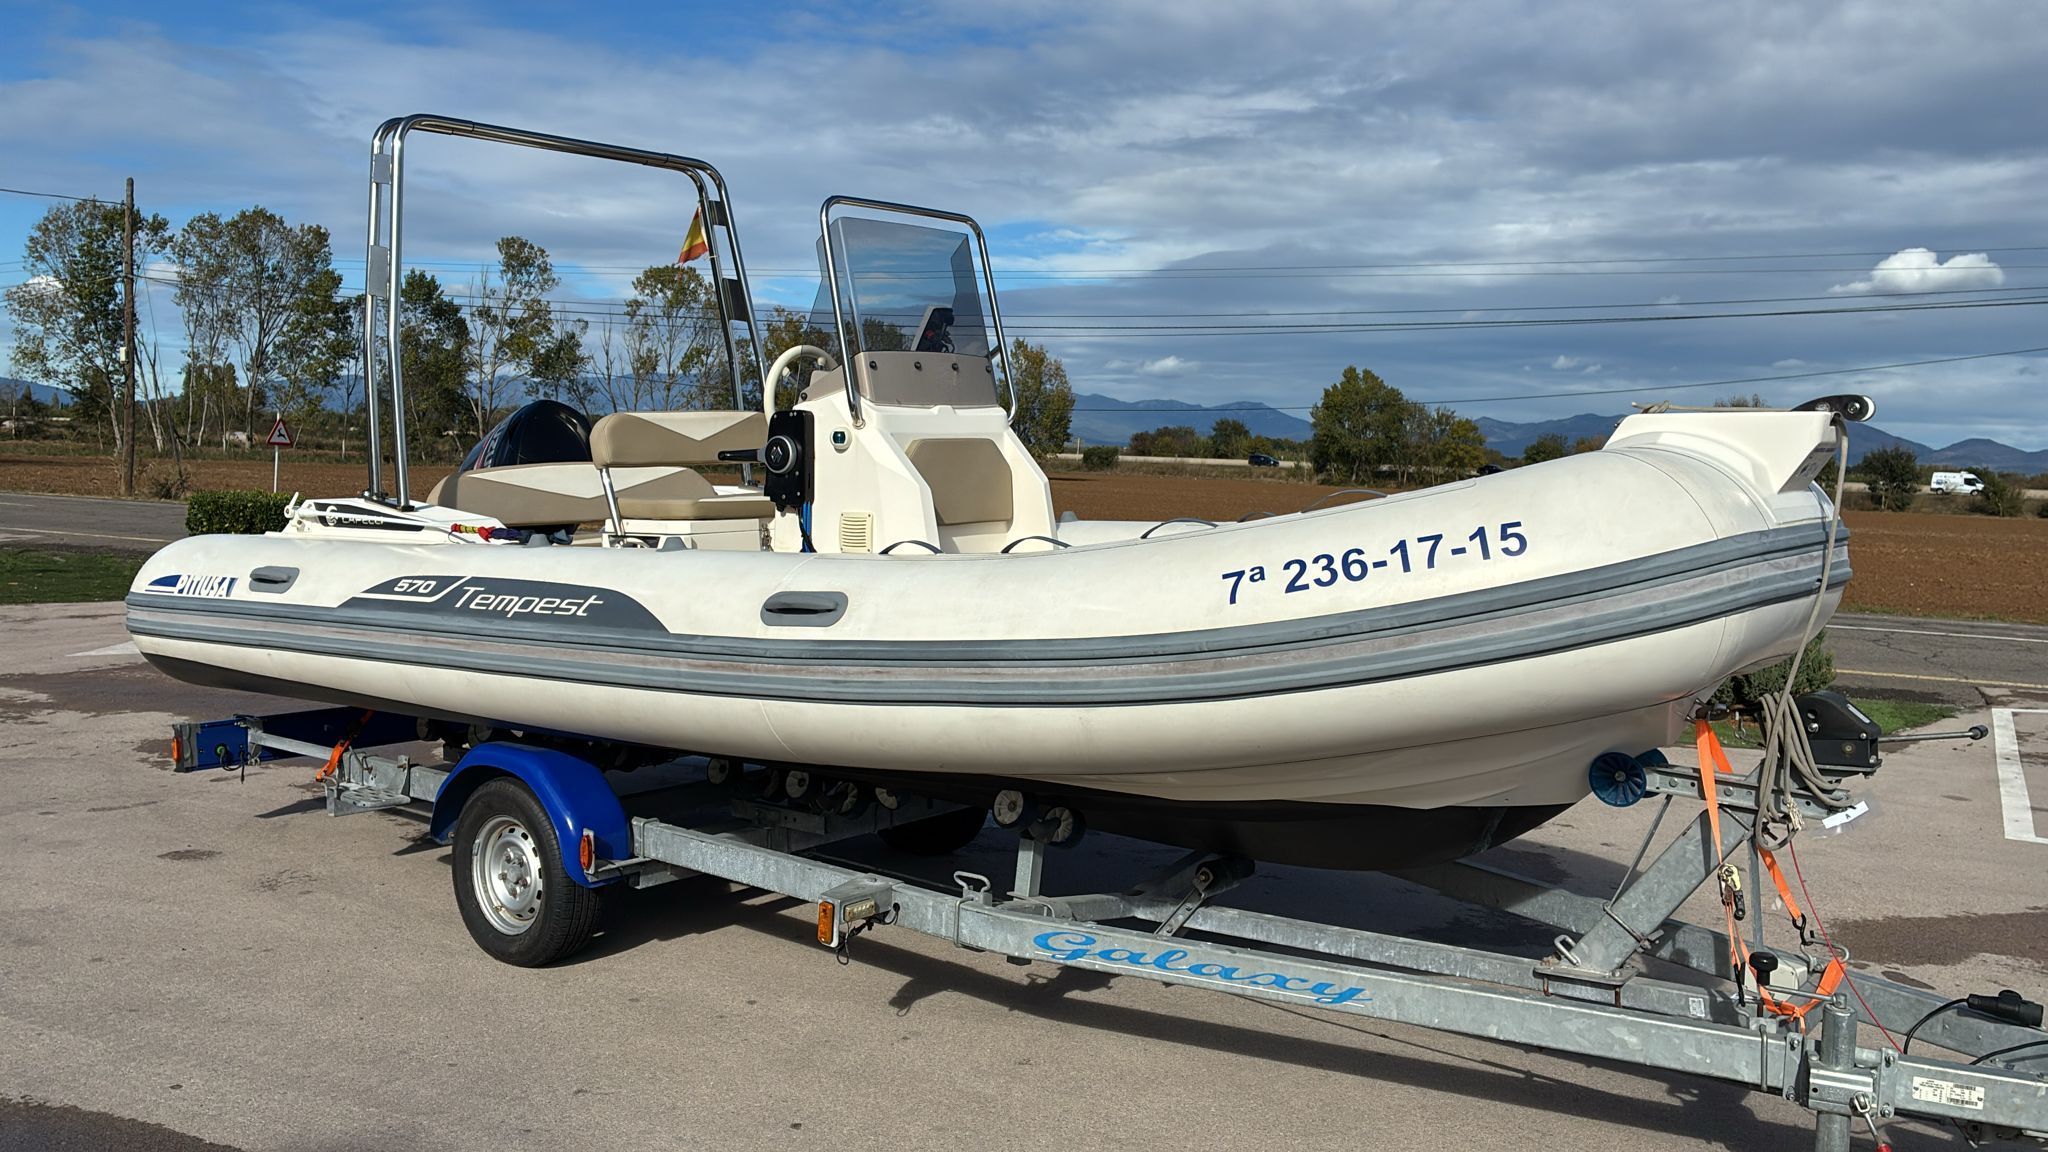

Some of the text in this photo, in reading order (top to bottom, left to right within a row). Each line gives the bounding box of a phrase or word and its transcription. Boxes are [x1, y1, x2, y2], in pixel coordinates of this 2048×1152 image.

[174, 574, 230, 597] PITIUSA
[1221, 521, 1528, 605] 7ª 236-17-15
[394, 579, 604, 617] 570 Tempest
[1033, 931, 1373, 1004] Galaxy
